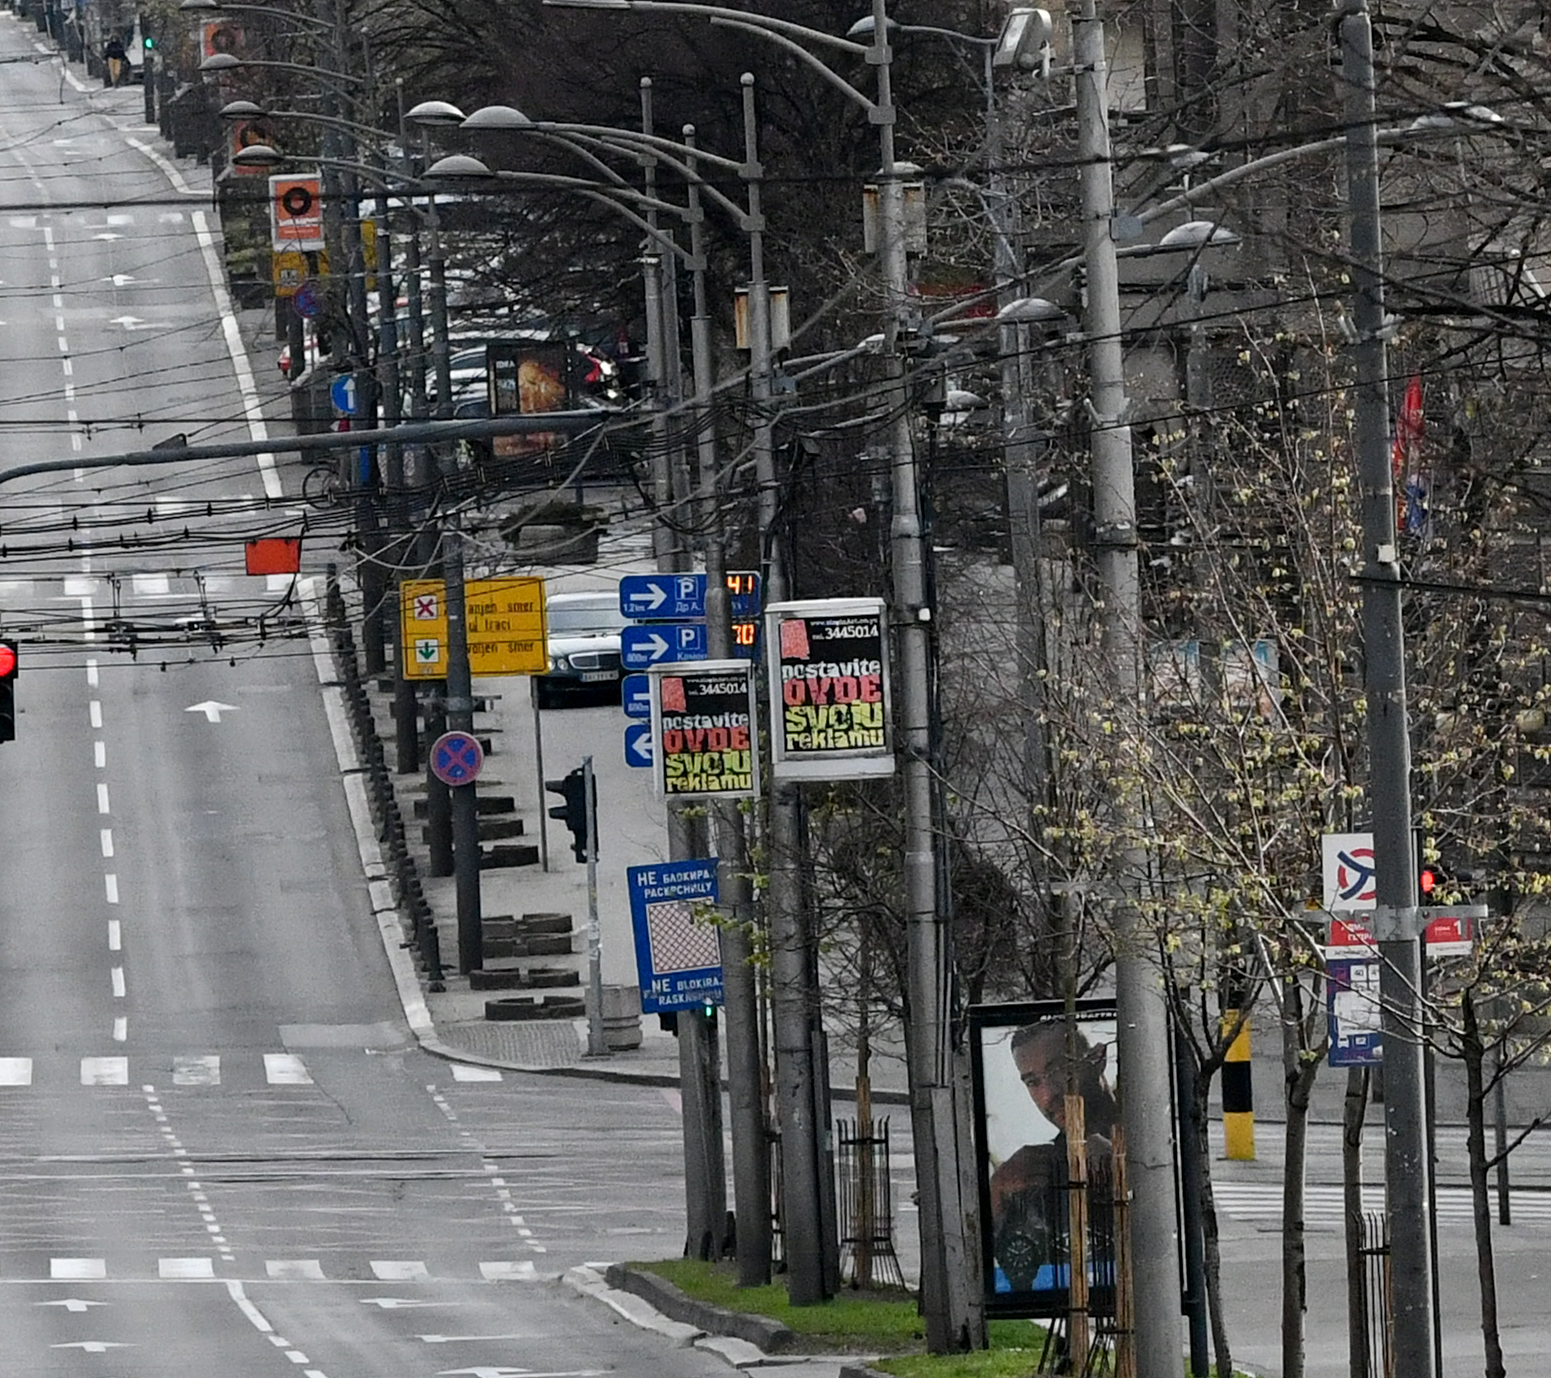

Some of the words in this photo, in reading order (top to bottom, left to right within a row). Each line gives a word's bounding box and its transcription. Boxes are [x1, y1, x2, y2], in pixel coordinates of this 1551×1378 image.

[824, 625, 879, 640] 3445014
[699, 682, 748, 696] 3445014
[783, 674, 882, 706] OVDE
[785, 700, 884, 732] svoju
[664, 726, 750, 754] OVDE
[786, 728, 885, 751] reklamu
[666, 748, 752, 777] svoju
[666, 772, 753, 793] reklamu
[637, 871, 658, 887] НЕ
[662, 869, 715, 884] БЛОКИРА
[651, 978, 671, 993] NE
[676, 976, 723, 990] BLOKIRA
